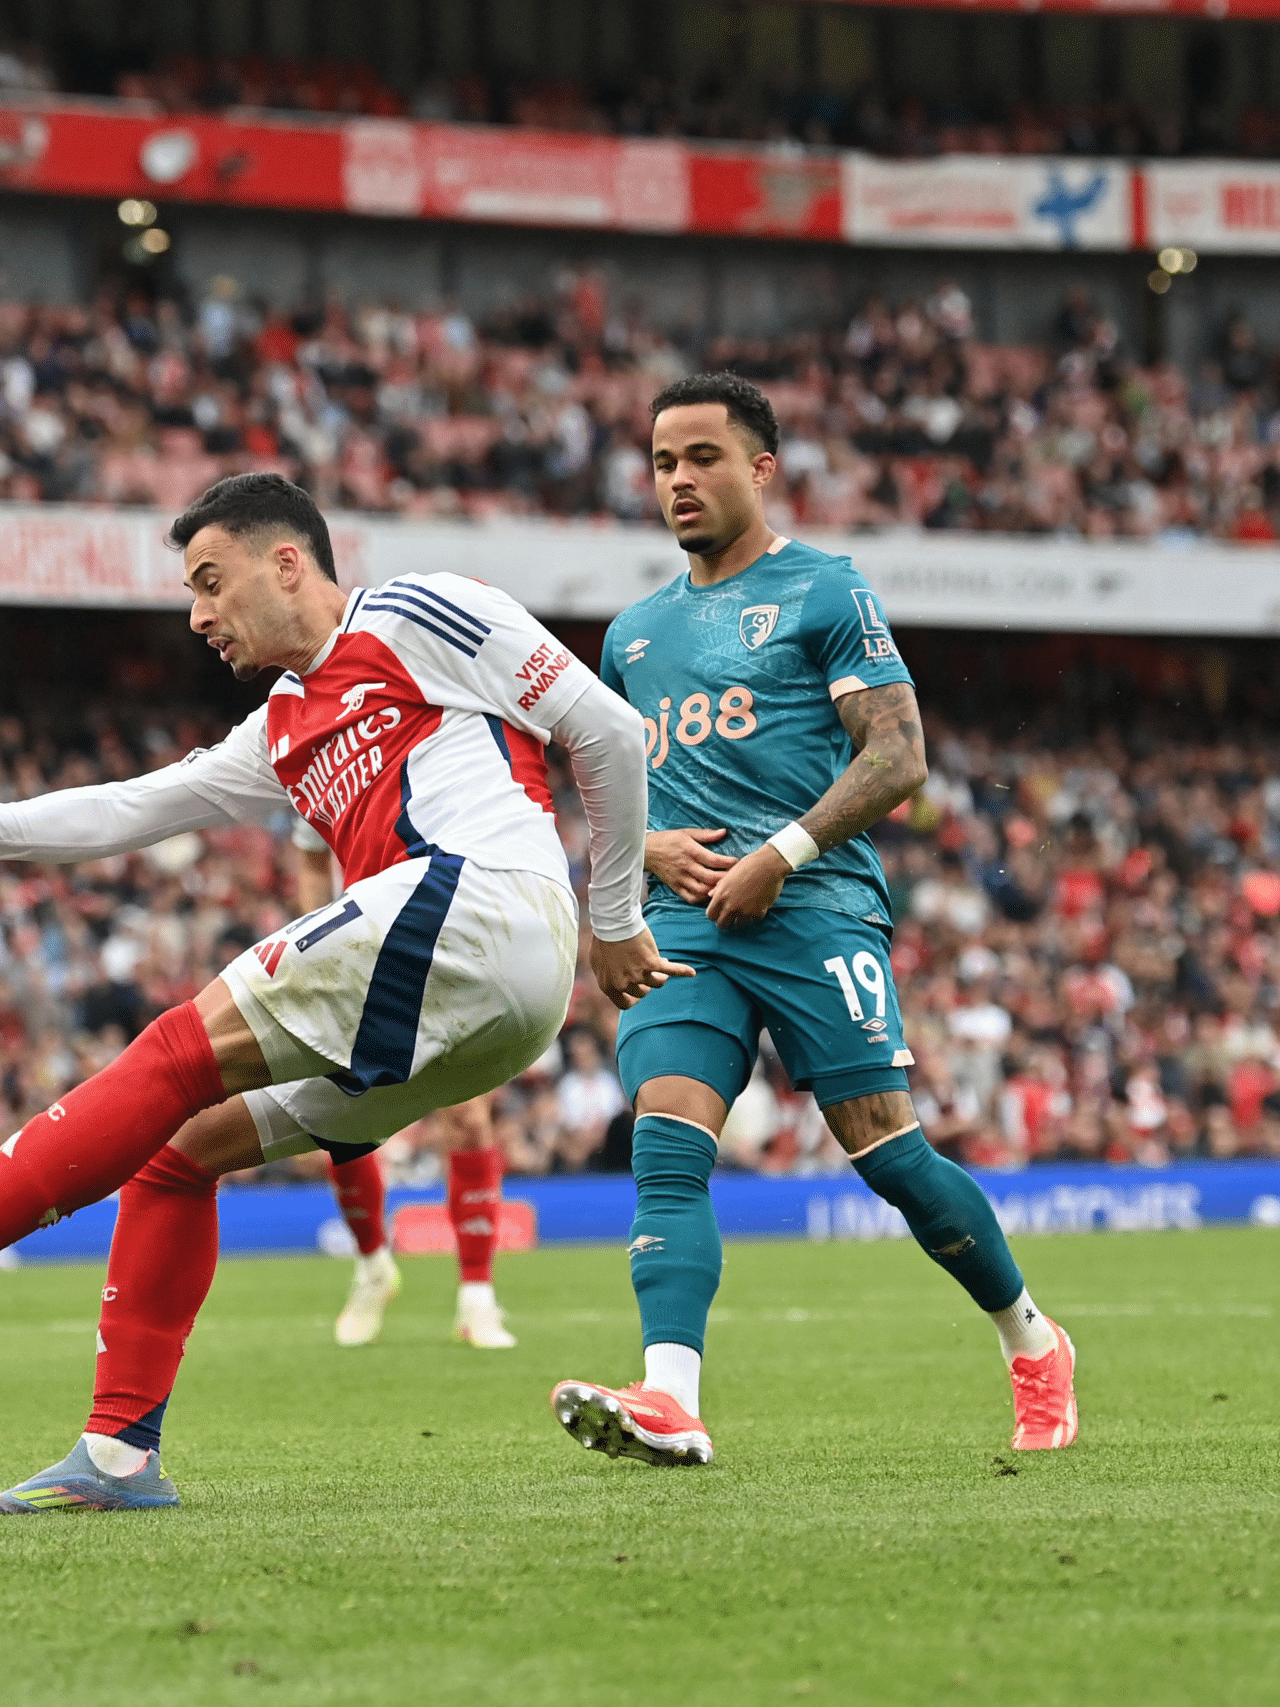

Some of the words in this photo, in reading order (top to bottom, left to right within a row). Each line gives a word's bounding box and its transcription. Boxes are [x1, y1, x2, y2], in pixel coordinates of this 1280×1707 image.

[515, 643, 554, 680] VISIT
[286, 706, 401, 821] Emirates
[327, 745, 384, 822] BETTER
[823, 950, 886, 1021] 19
